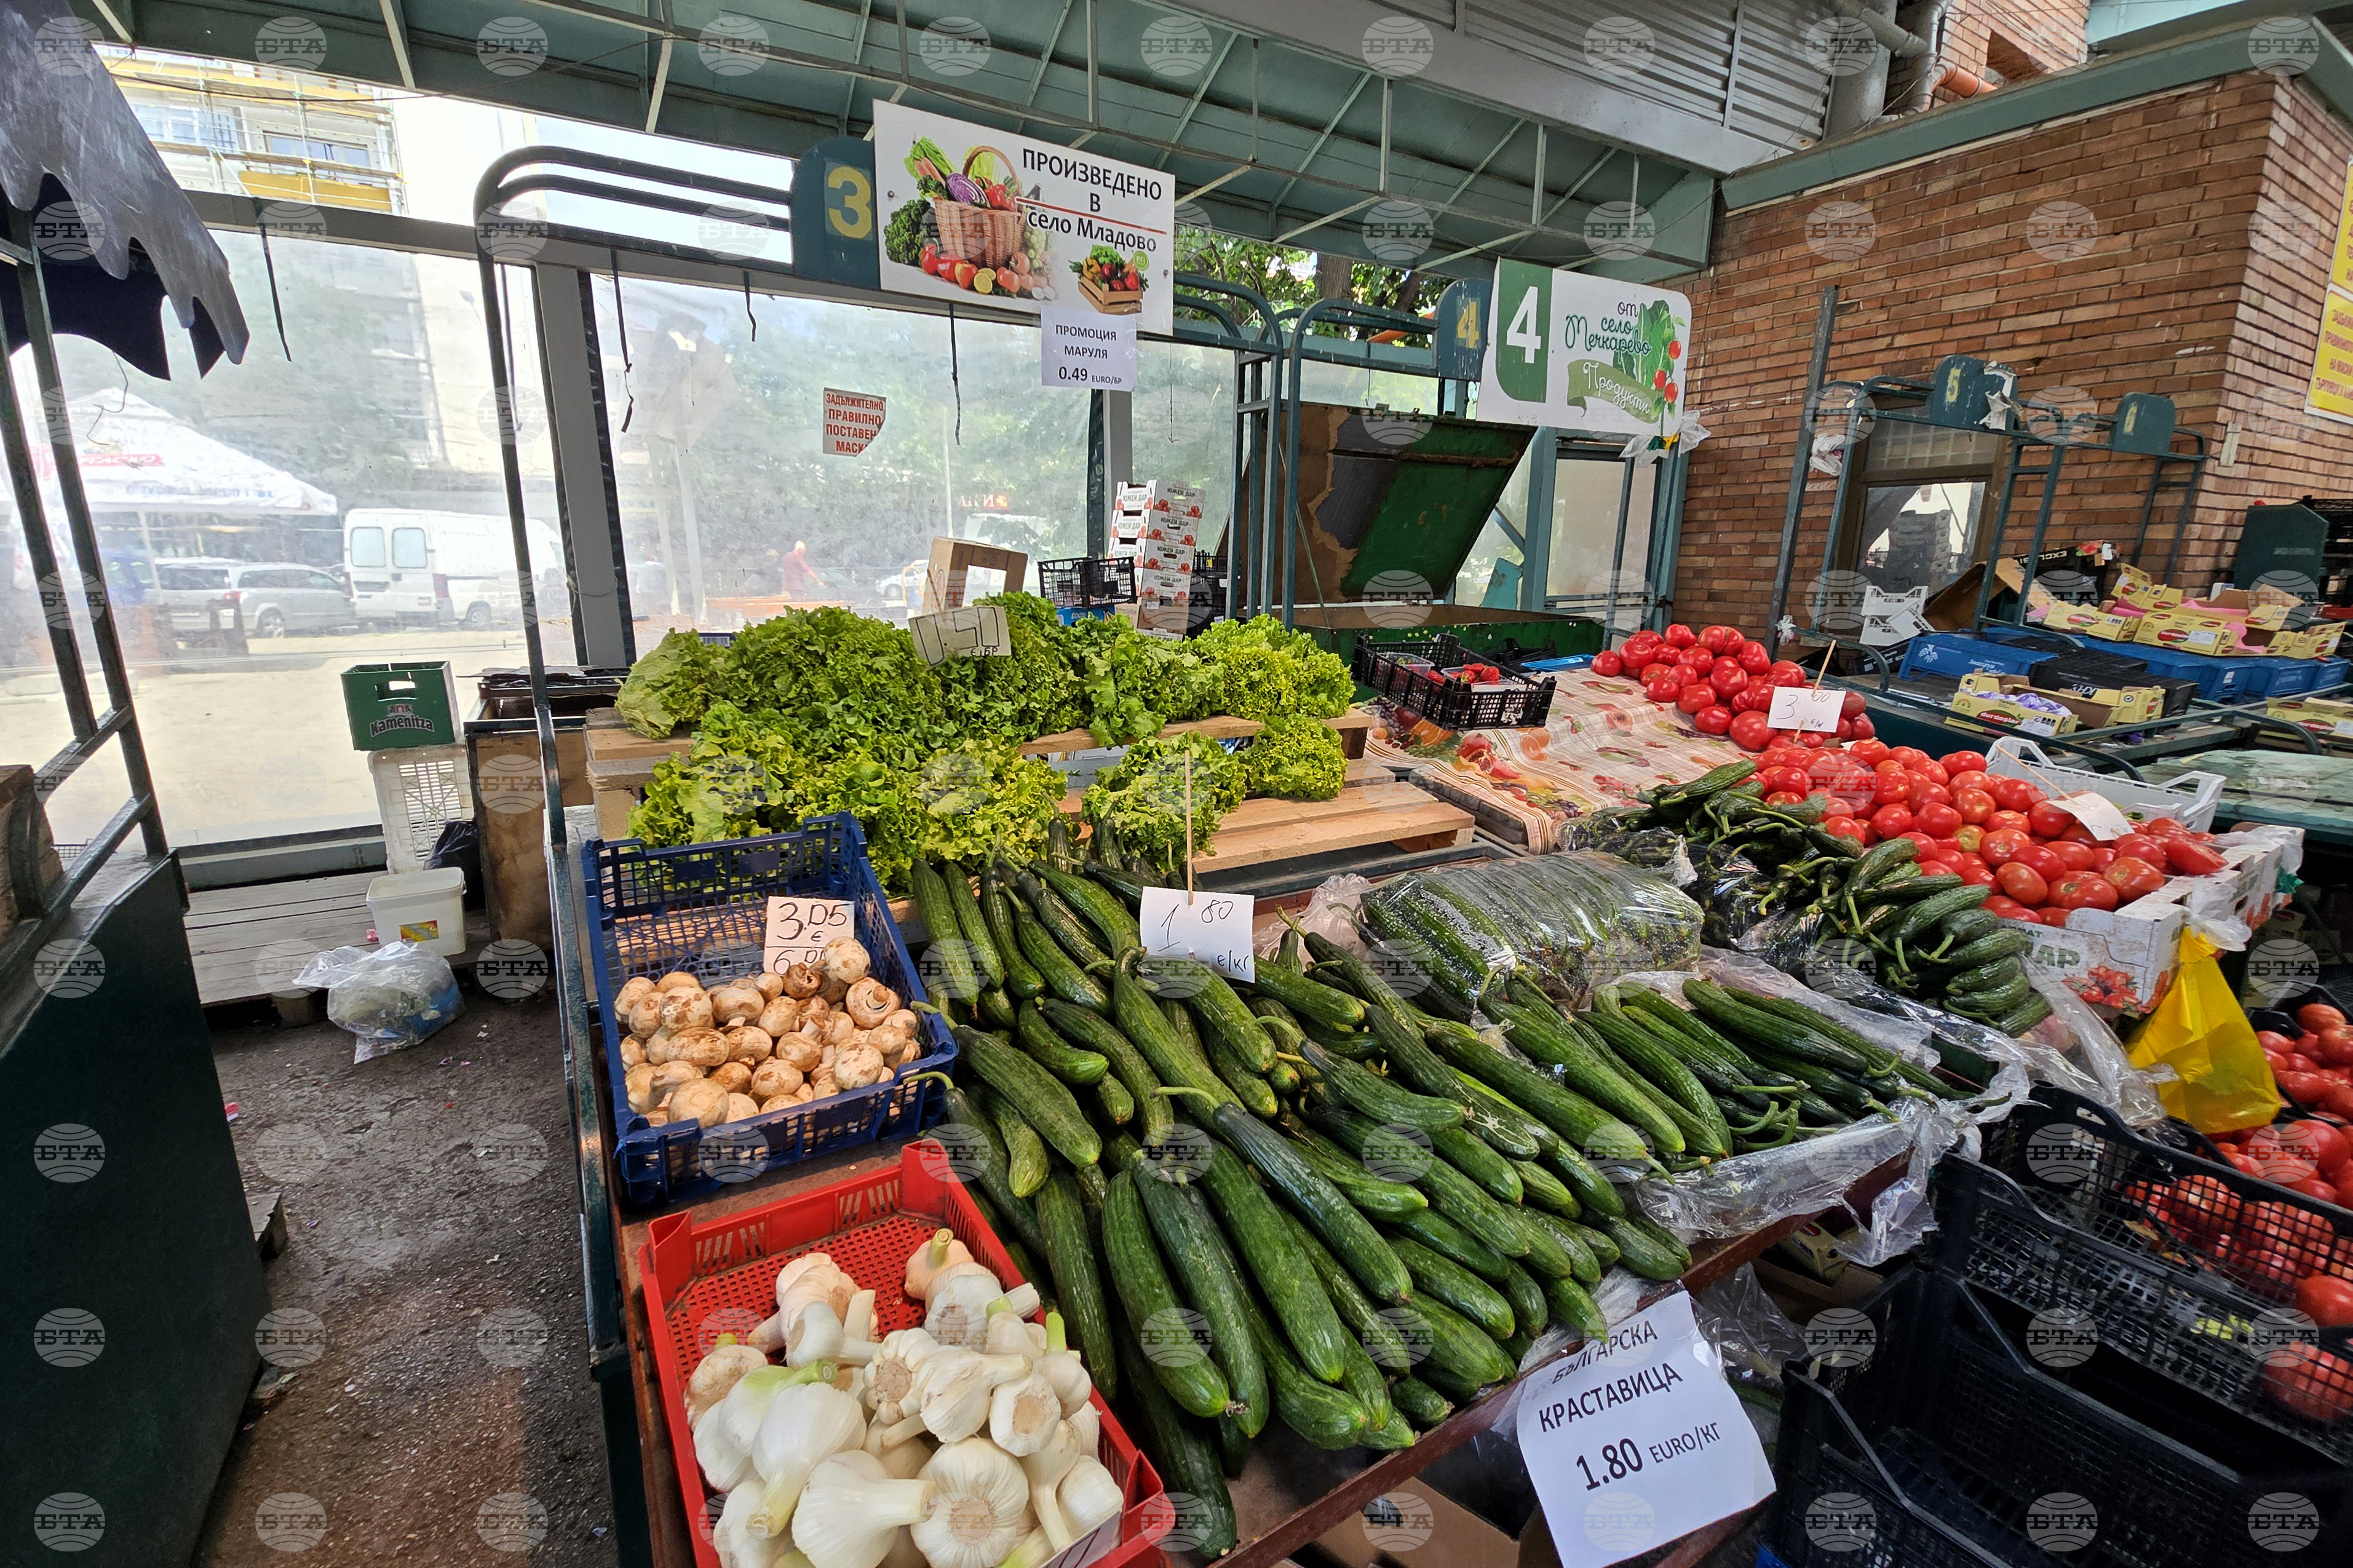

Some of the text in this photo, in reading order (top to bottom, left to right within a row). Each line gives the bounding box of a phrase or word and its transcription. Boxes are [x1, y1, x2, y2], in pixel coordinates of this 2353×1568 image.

[1023, 148, 1162, 200] ПРОИЗВЕДЕНО
[828, 166, 873, 239] 3
[1090, 192, 1101, 212] В
[1028, 211, 1156, 251] село Младово
[1457, 301, 1480, 348] 4
[1507, 286, 1541, 363] 4
[1601, 317, 1633, 335] село
[1617, 301, 1638, 317] от
[1055, 325, 1117, 342] ПРОМОЦИЯ
[1064, 345, 1108, 359] МАРУЛЯ
[1565, 315, 1651, 363] Мечкарево
[1058, 366, 1088, 381] 0.49
[1582, 362, 1650, 414] Продукти
[1946, 368, 1961, 403] 5
[826, 393, 884, 411] ЗАДЪЛЖИТЕЛНО
[828, 408, 881, 426] ПРАВИЛНО
[370, 715, 434, 736] Kamenitza
[1776, 694, 1798, 720] 3
[1157, 899, 1234, 952] 1 80
[1552, 1320, 1658, 1385] БЪЛГАРСКА
[1539, 1363, 1684, 1433] КРАСТАВИЦА
[1576, 1422, 1721, 1491] 1.80 EURO/КГ
